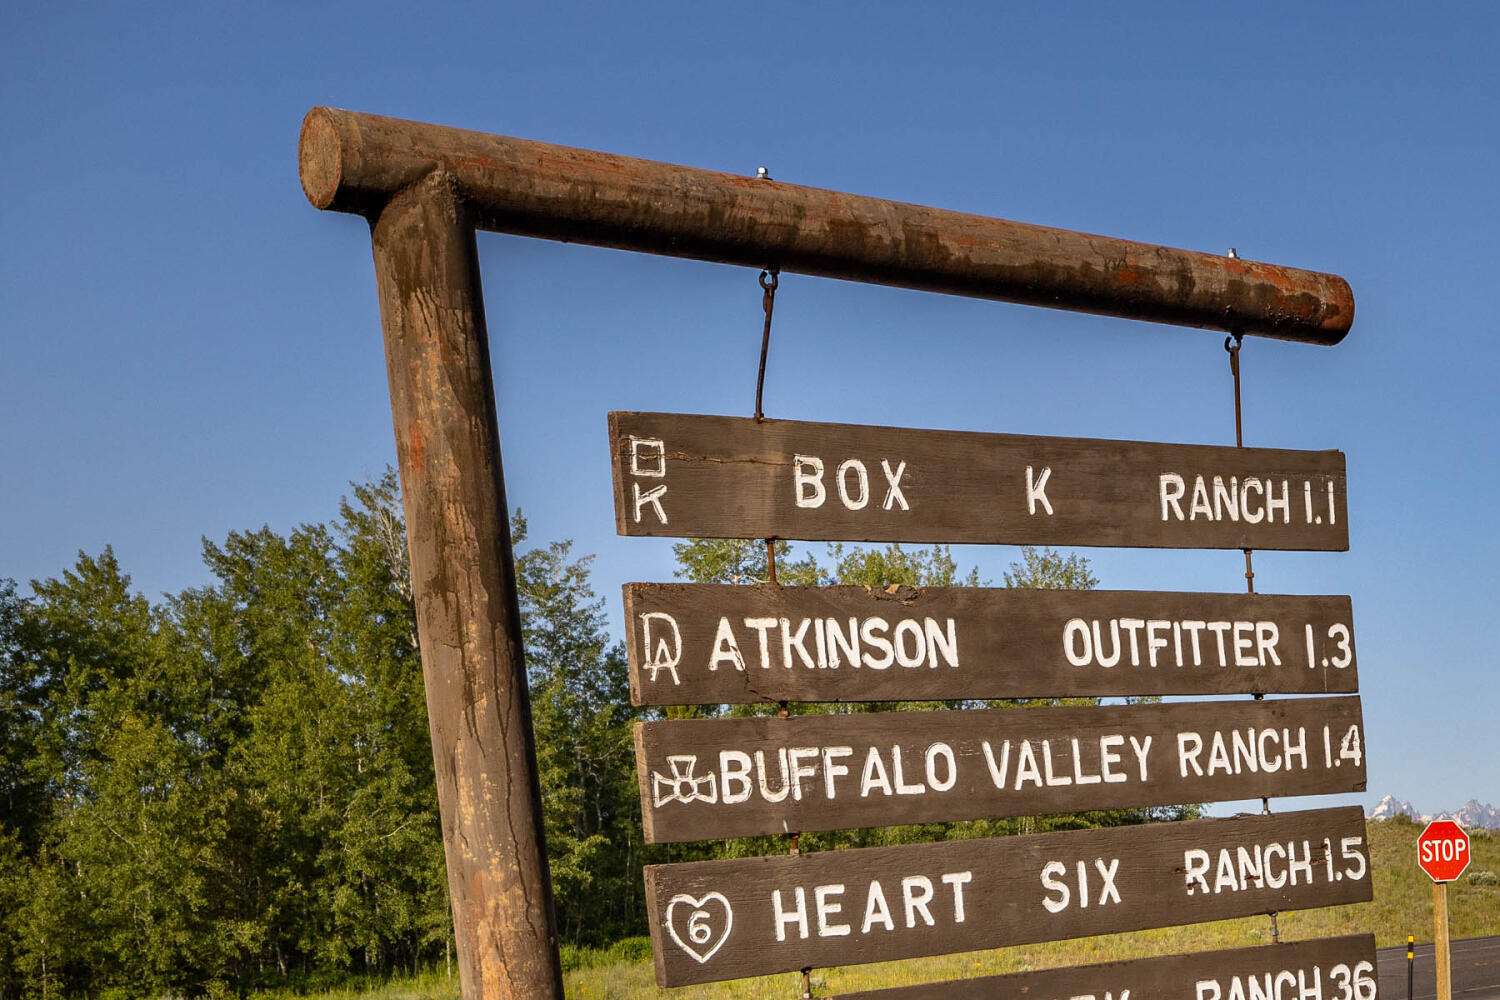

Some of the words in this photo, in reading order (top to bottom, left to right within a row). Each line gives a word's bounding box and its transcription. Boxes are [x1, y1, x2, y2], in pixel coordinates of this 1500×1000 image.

[793, 453, 910, 511] BOX
[1025, 465, 1054, 516] K
[1159, 473, 1290, 524] RANCH
[708, 616, 960, 672] ATKINSON
[1062, 617, 1282, 668] OUTFITTER
[1305, 623, 1352, 669] 1.3
[719, 742, 958, 804] BUFFALO
[981, 734, 1153, 791] VALLEY
[1176, 726, 1308, 778] RANCH
[1323, 724, 1362, 769] 1.4
[1422, 838, 1466, 863] STOP
[771, 870, 973, 942] HEART
[1039, 858, 1122, 914] SIX
[1184, 840, 1313, 896] RANCH
[1324, 836, 1366, 882] 1.5
